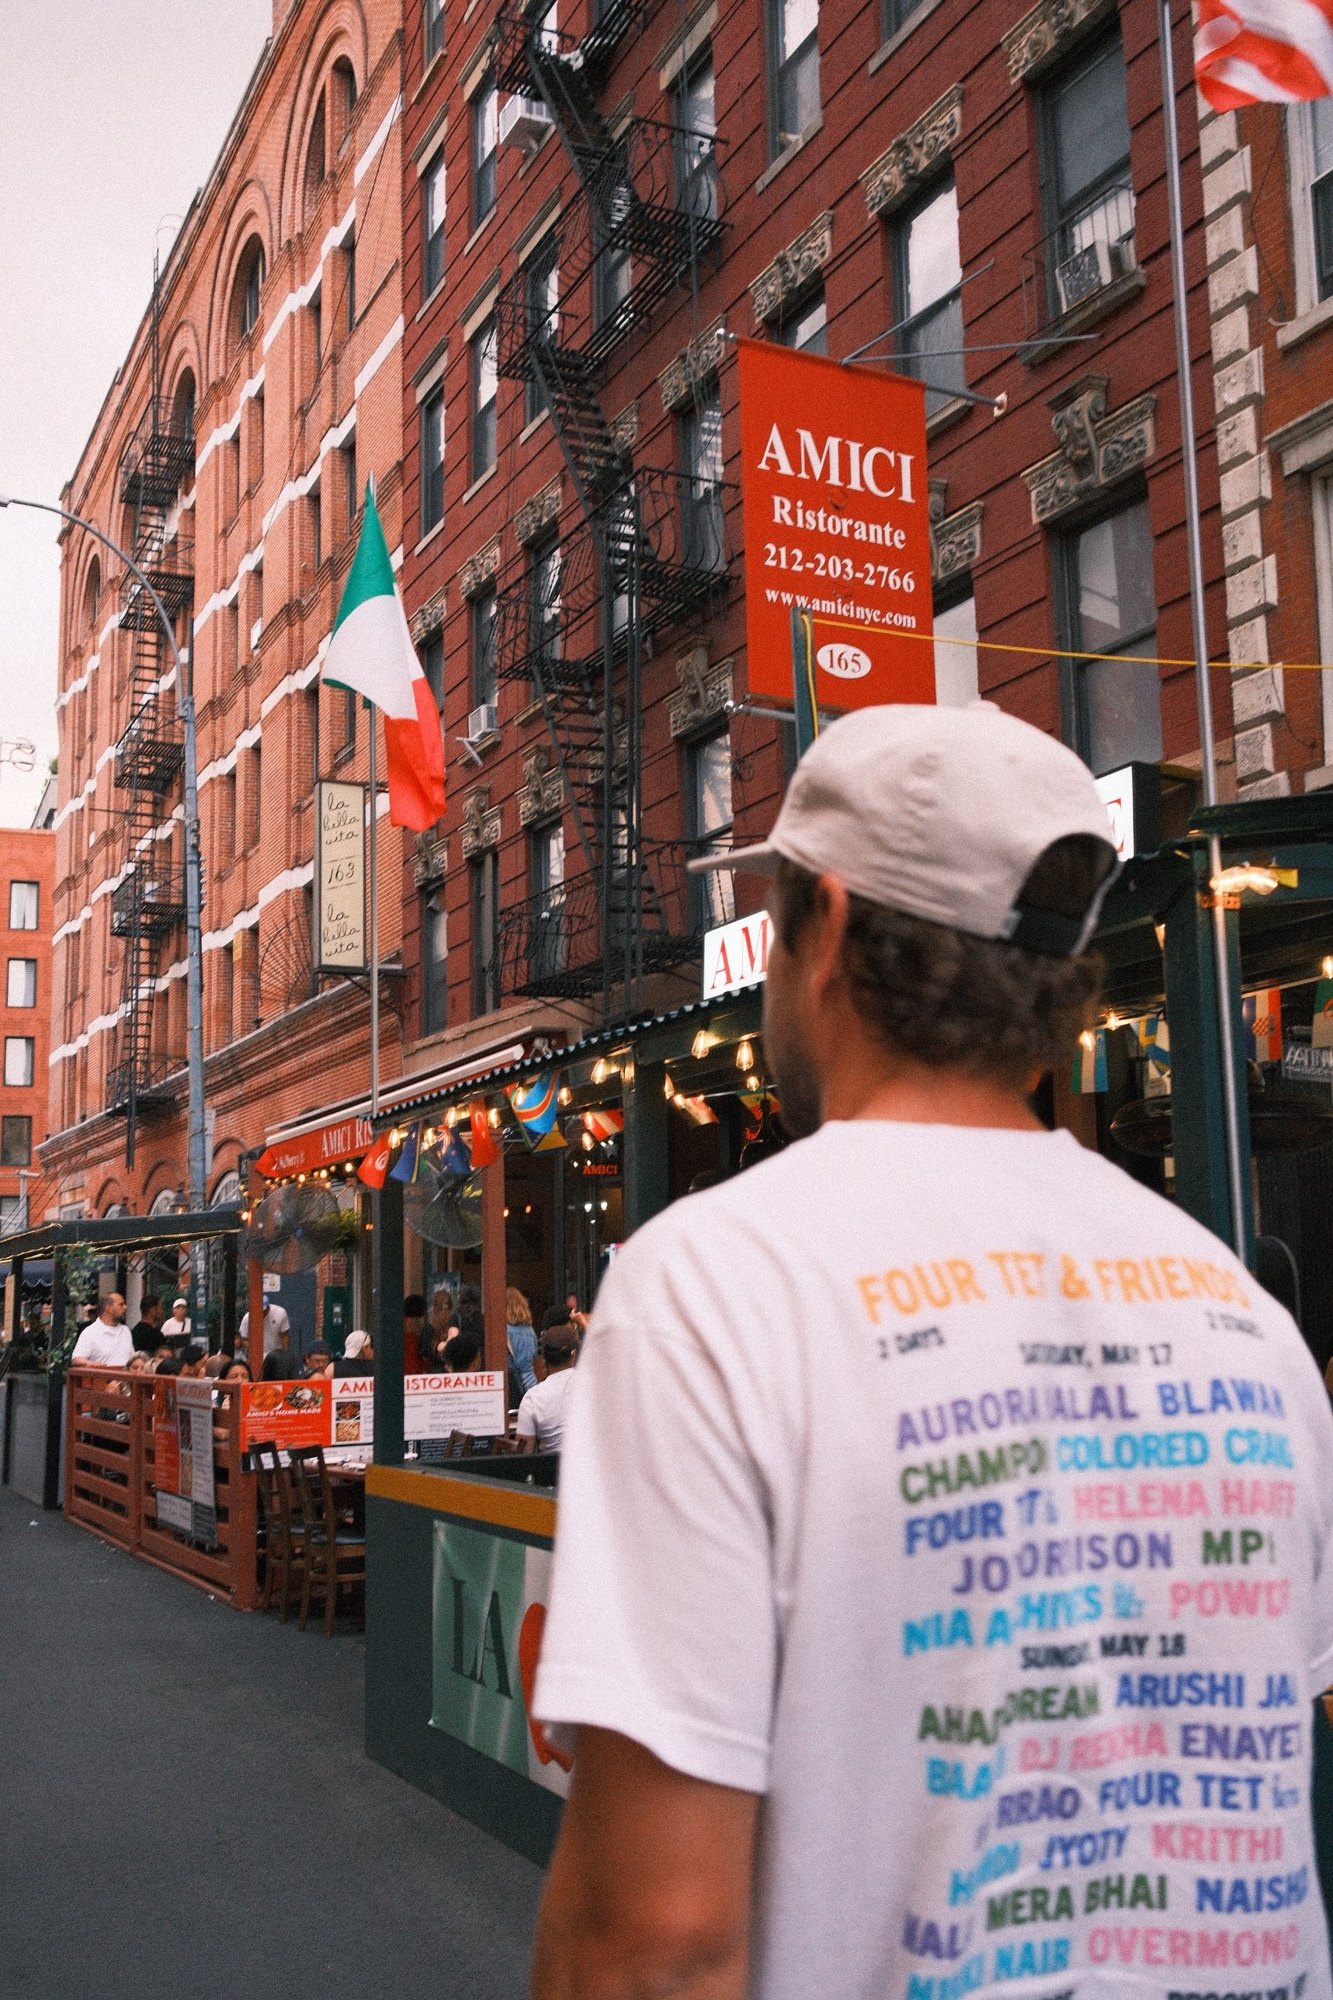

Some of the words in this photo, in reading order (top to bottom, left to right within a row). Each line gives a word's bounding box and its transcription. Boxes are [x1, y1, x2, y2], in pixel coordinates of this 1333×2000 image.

[758, 423, 916, 503] AMICI
[772, 495, 906, 550] Ristorante
[764, 543, 916, 594] 212-203-2766
[765, 587, 917, 629] www.amicinyc.com
[827, 649, 861, 673] 165
[328, 862, 355, 884] 163
[321, 1125, 351, 1158] AMICI
[583, 1164, 618, 1176] AMICI
[857, 1258, 987, 1324] FOUR
[1056, 1432, 1212, 1471] COLORED
[904, 1499, 1006, 1557] FOUR
[1157, 1633, 1186, 1658] 18
[1115, 1672, 1246, 1708] ARUSHI
[1195, 1773, 1265, 1812] TET
[1151, 1824, 1284, 1864] KRITHI
